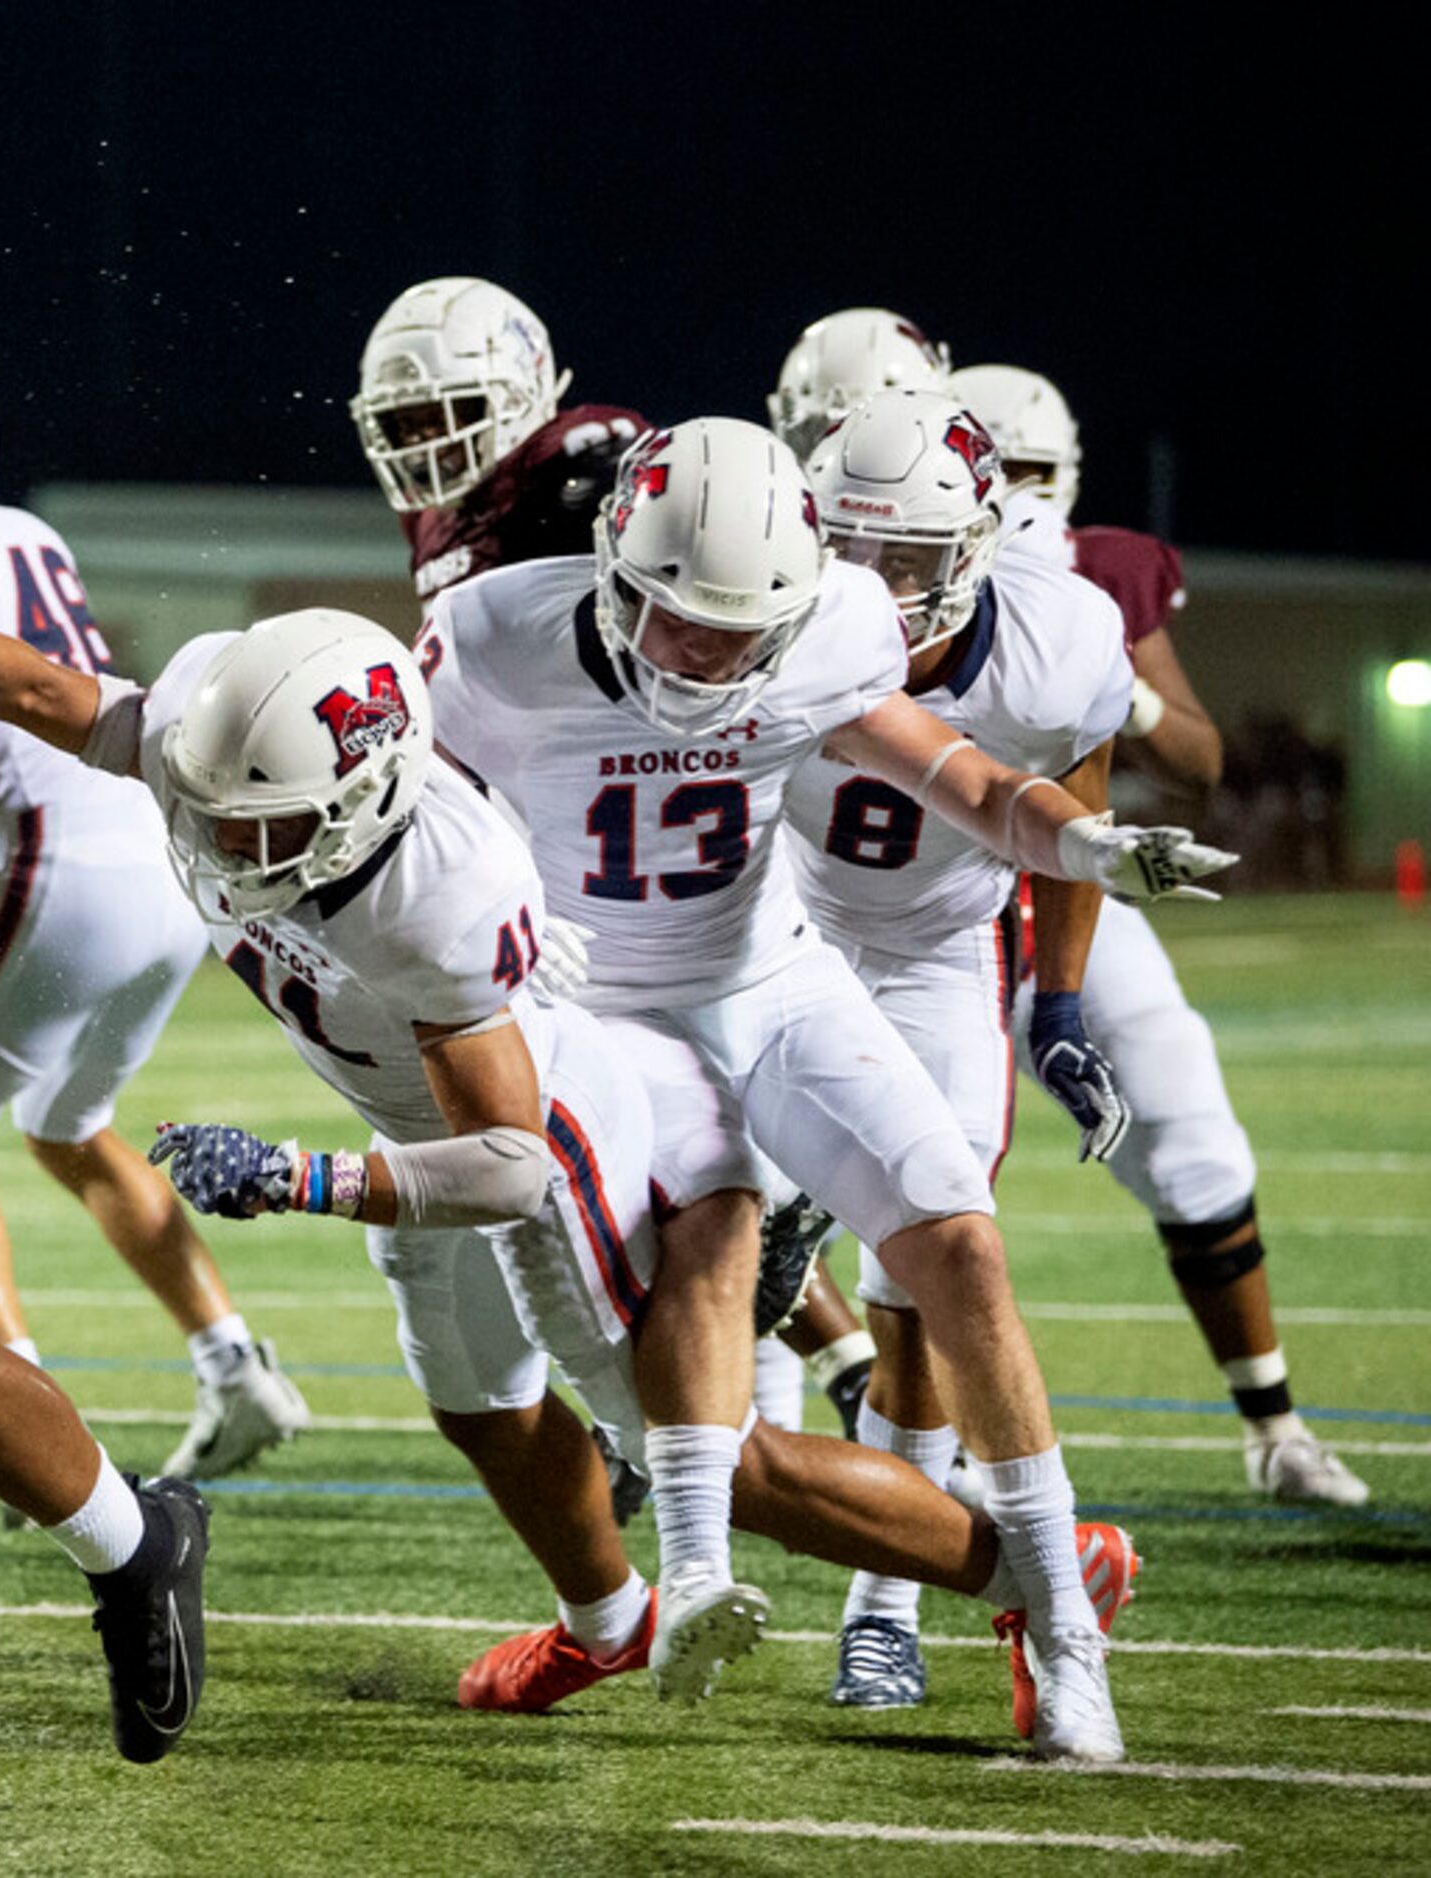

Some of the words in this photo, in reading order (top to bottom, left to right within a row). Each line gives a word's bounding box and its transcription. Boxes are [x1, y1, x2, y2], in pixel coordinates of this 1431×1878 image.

[599, 749, 742, 777] BRONCOS
[581, 777, 751, 902] 13
[824, 774, 925, 871] 8
[492, 903, 541, 990] 41
